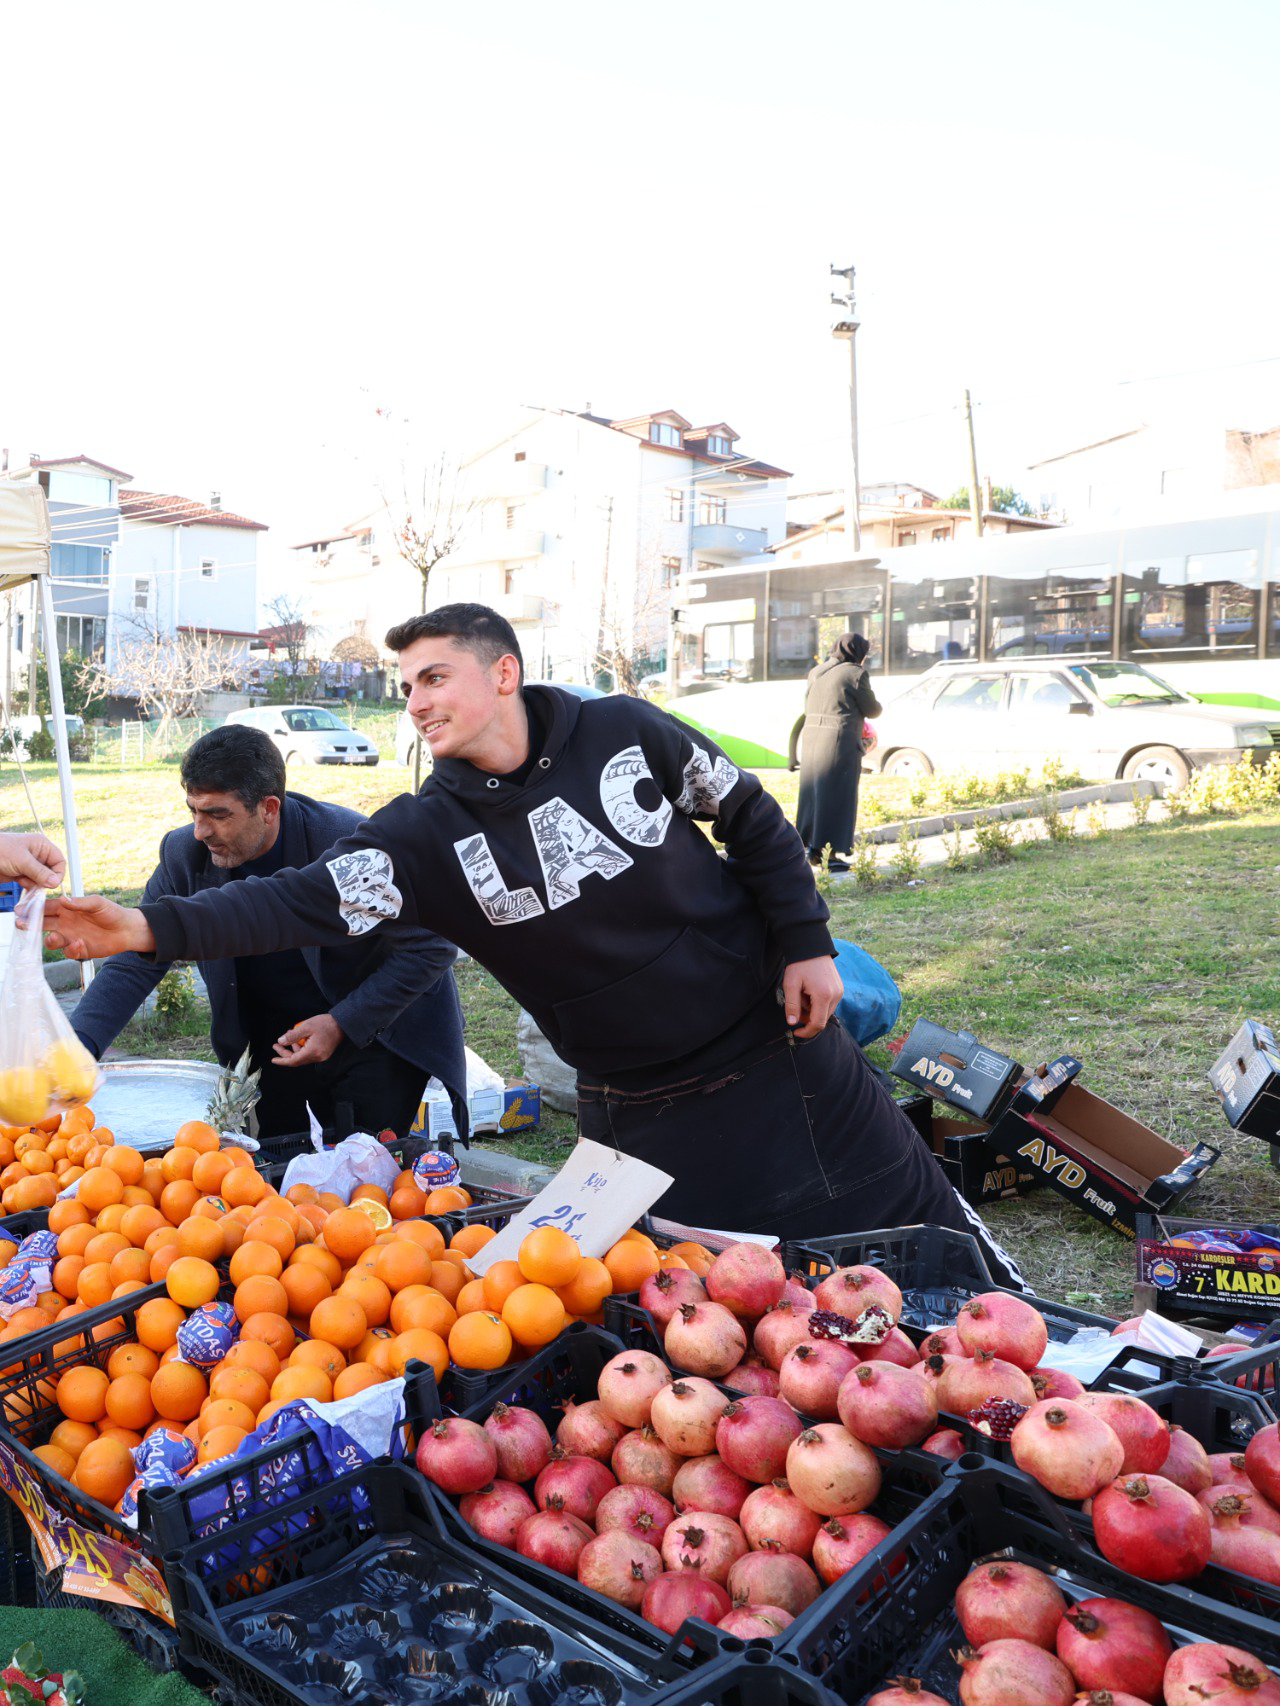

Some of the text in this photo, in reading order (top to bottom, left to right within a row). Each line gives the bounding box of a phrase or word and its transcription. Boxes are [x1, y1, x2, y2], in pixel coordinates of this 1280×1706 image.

[910, 1056, 955, 1087] AYD
[951, 1083, 974, 1100] Fruit
[982, 1166, 1017, 1193] AYD
[1017, 1137, 1087, 1189] AYD
[1083, 1187, 1117, 1216] Fruit
[1194, 1277, 1205, 1292] 7
[14, 1463, 113, 1587] SOAŞ
